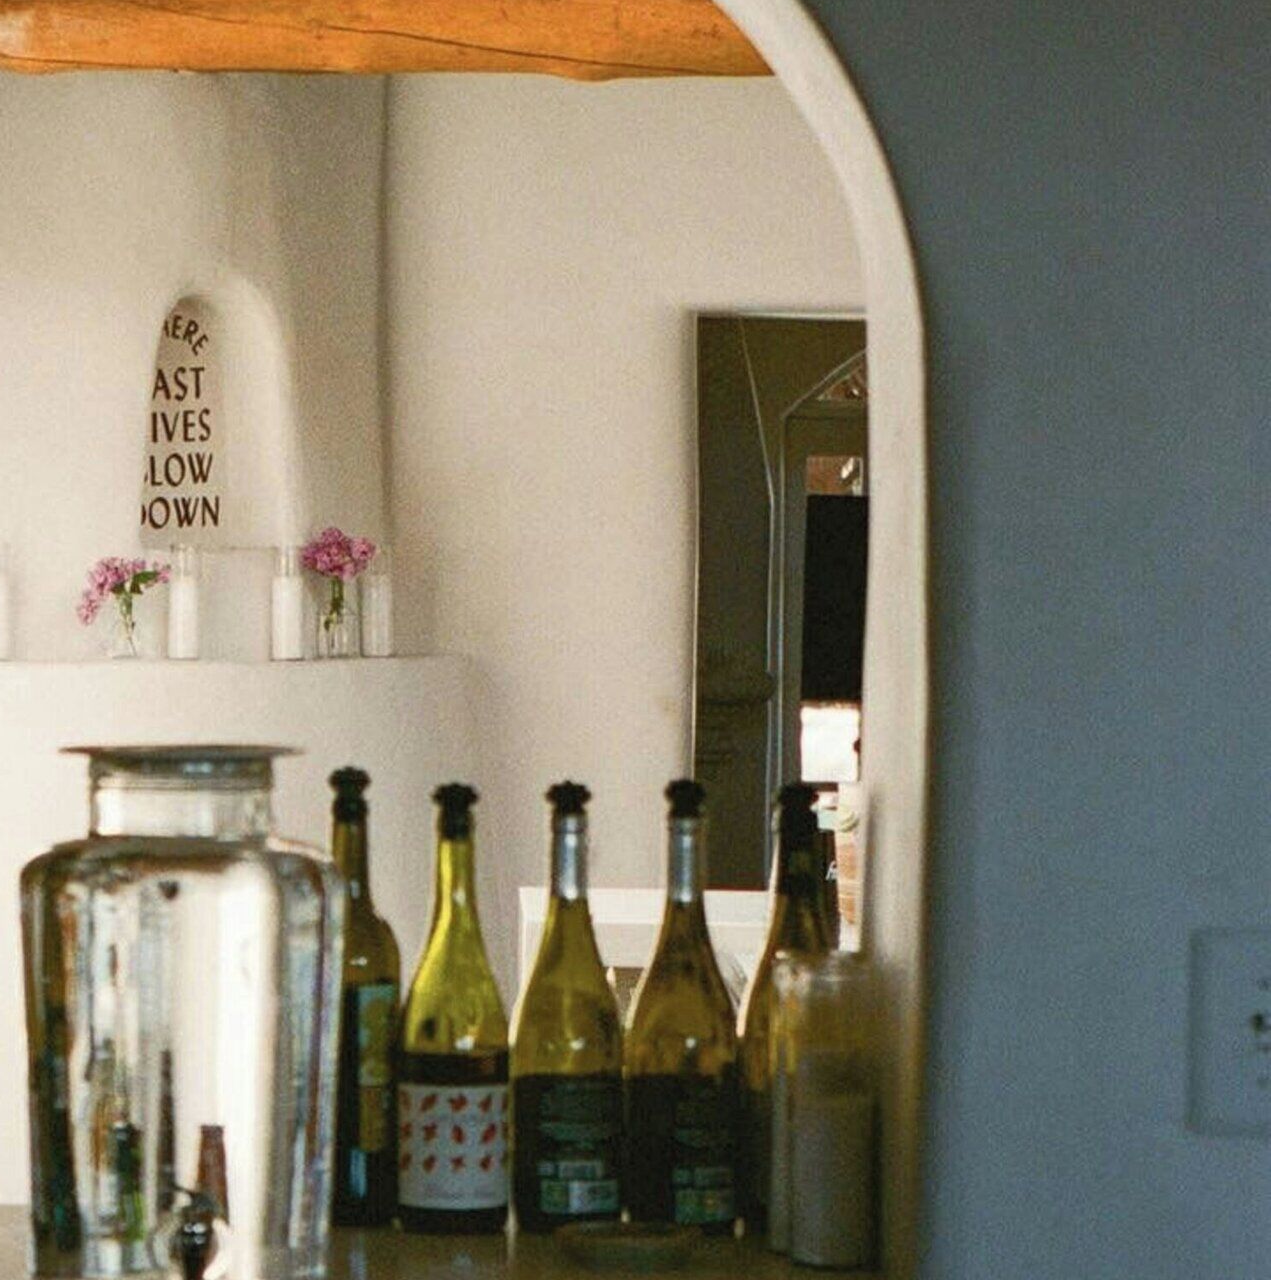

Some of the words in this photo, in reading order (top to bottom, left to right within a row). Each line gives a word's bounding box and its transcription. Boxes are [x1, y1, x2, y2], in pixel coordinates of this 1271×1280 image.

[152, 366, 205, 402] AST
[151, 407, 211, 443] IVES
[144, 452, 213, 487] LOW
